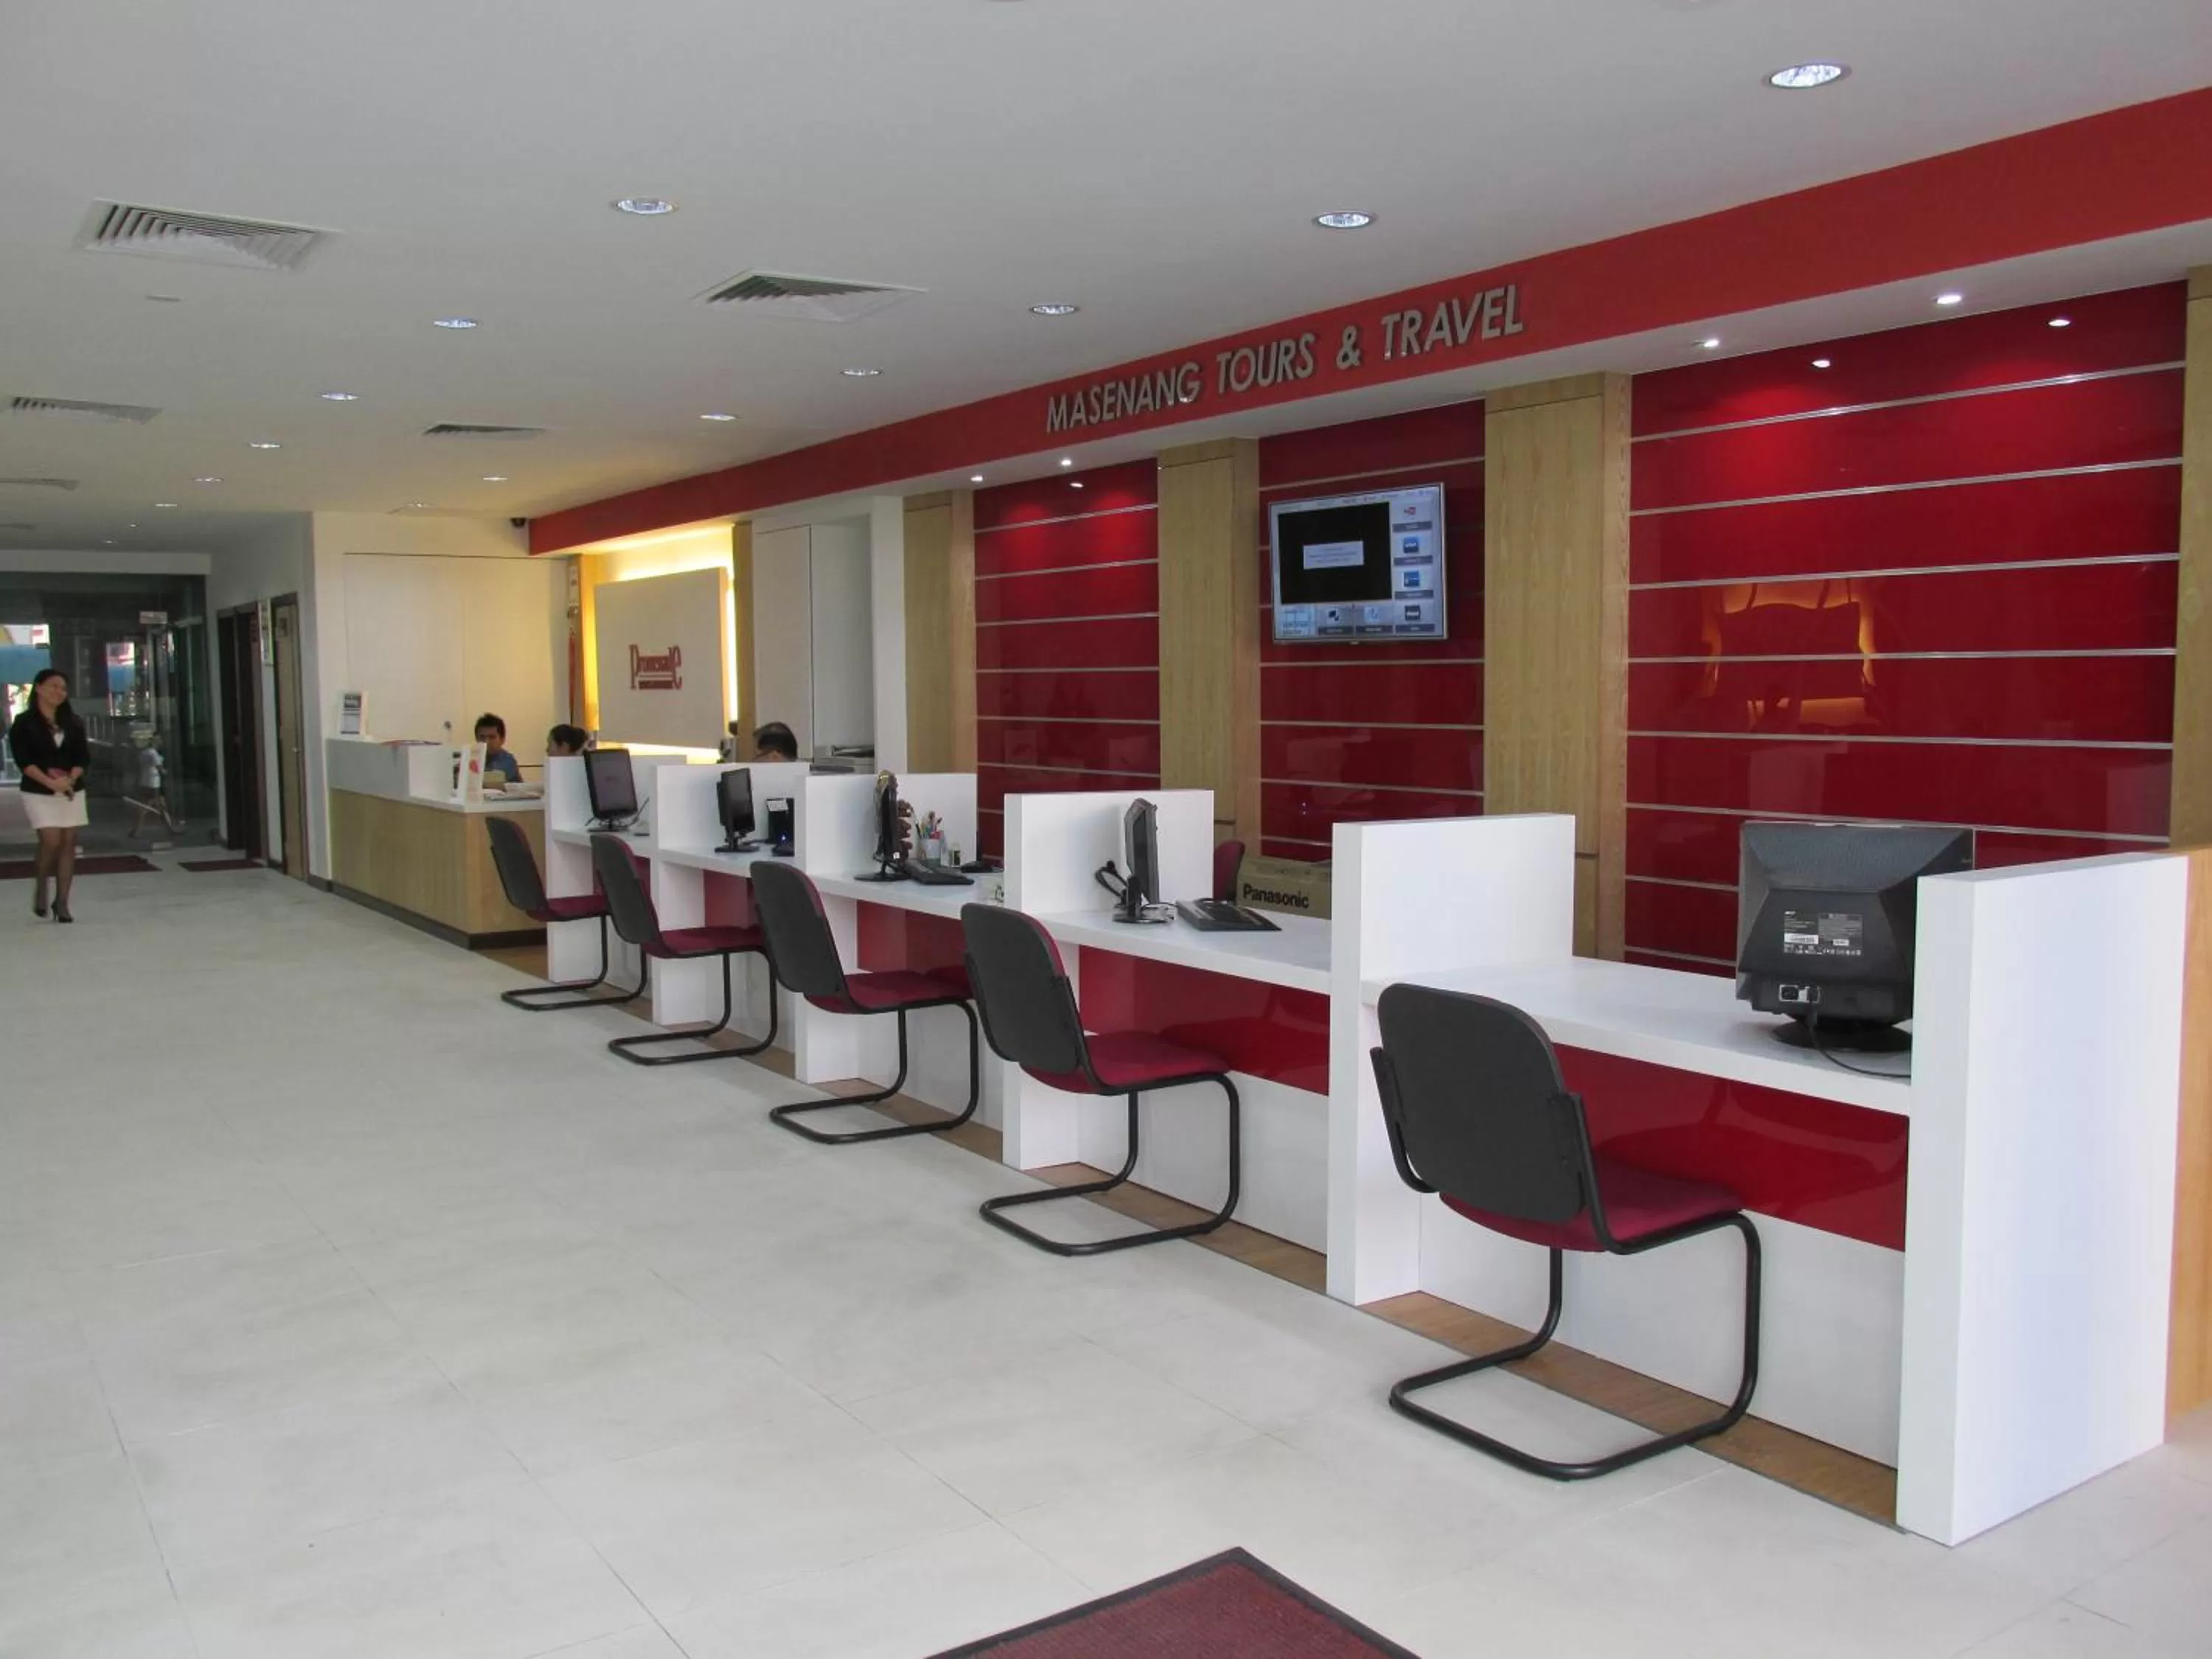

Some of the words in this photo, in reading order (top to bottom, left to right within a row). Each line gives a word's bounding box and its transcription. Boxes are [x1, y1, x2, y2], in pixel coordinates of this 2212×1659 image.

[1046, 361, 1202, 434] MASENANG
[1216, 333, 1315, 394] TOURS
[1335, 325, 1362, 370] &
[1381, 285, 1523, 361] TRAVEL
[1242, 883, 1310, 909] Panasonic
